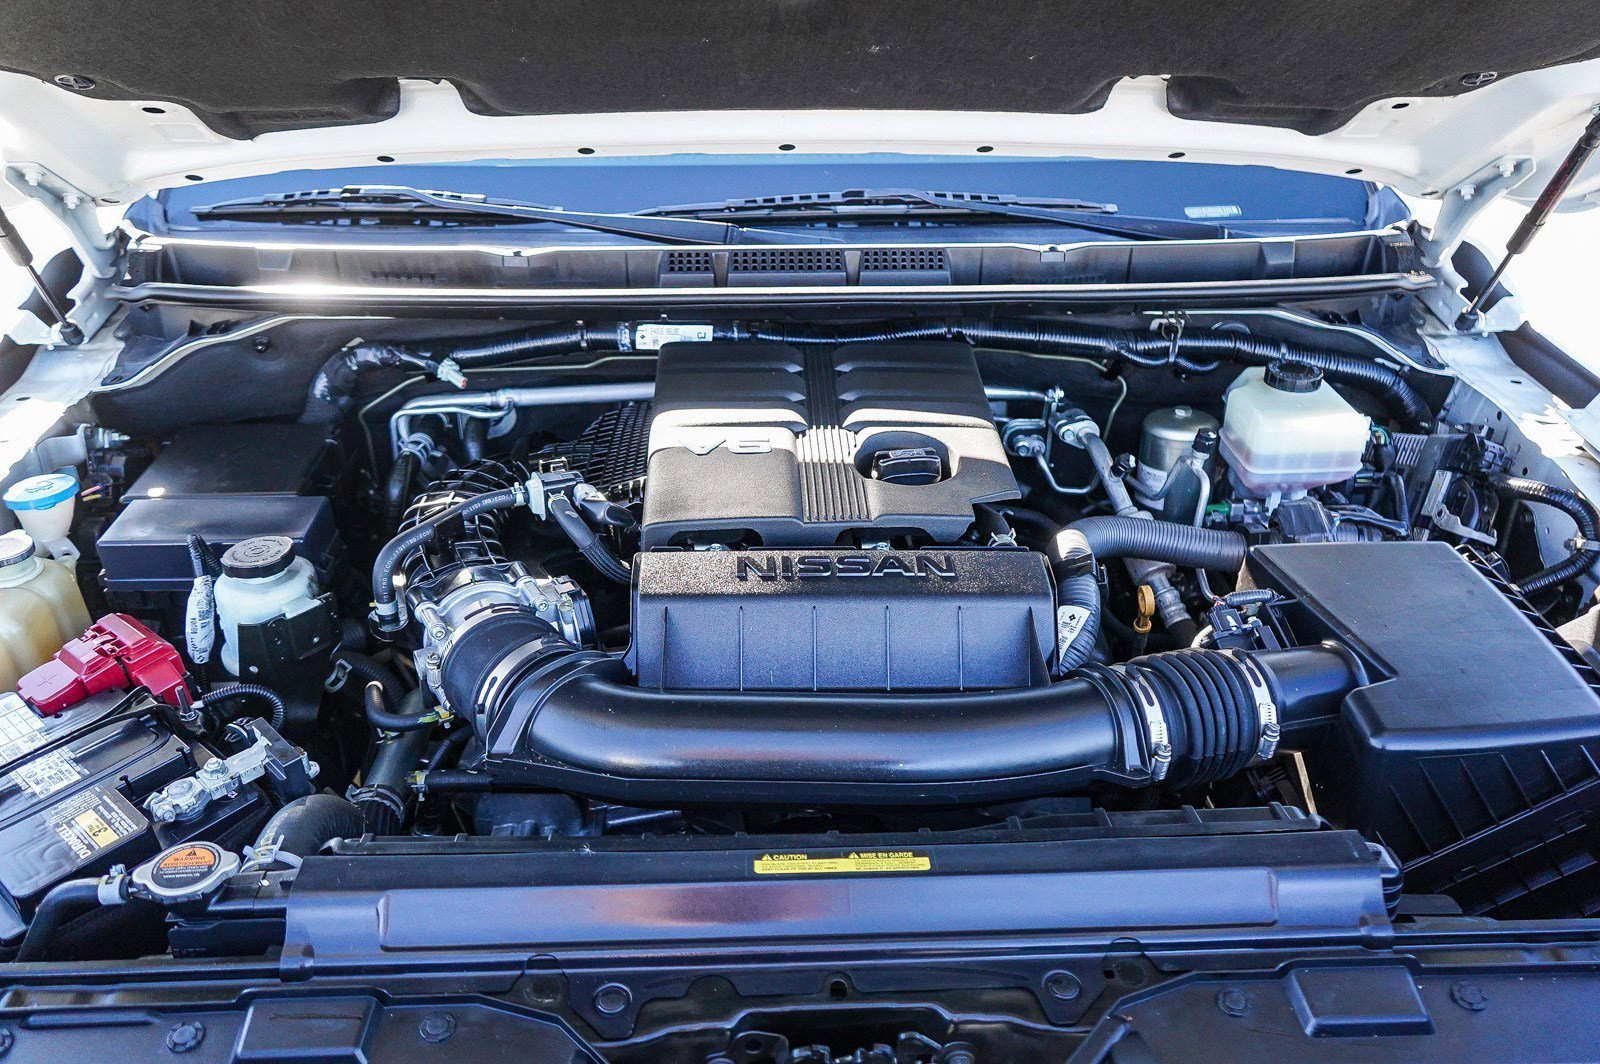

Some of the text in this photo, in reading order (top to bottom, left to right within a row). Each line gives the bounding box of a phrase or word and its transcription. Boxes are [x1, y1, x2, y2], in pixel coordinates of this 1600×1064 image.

[736, 555, 956, 580] NISSAN
[57, 823, 92, 859] DURACELL
[92, 827, 108, 837] 3
